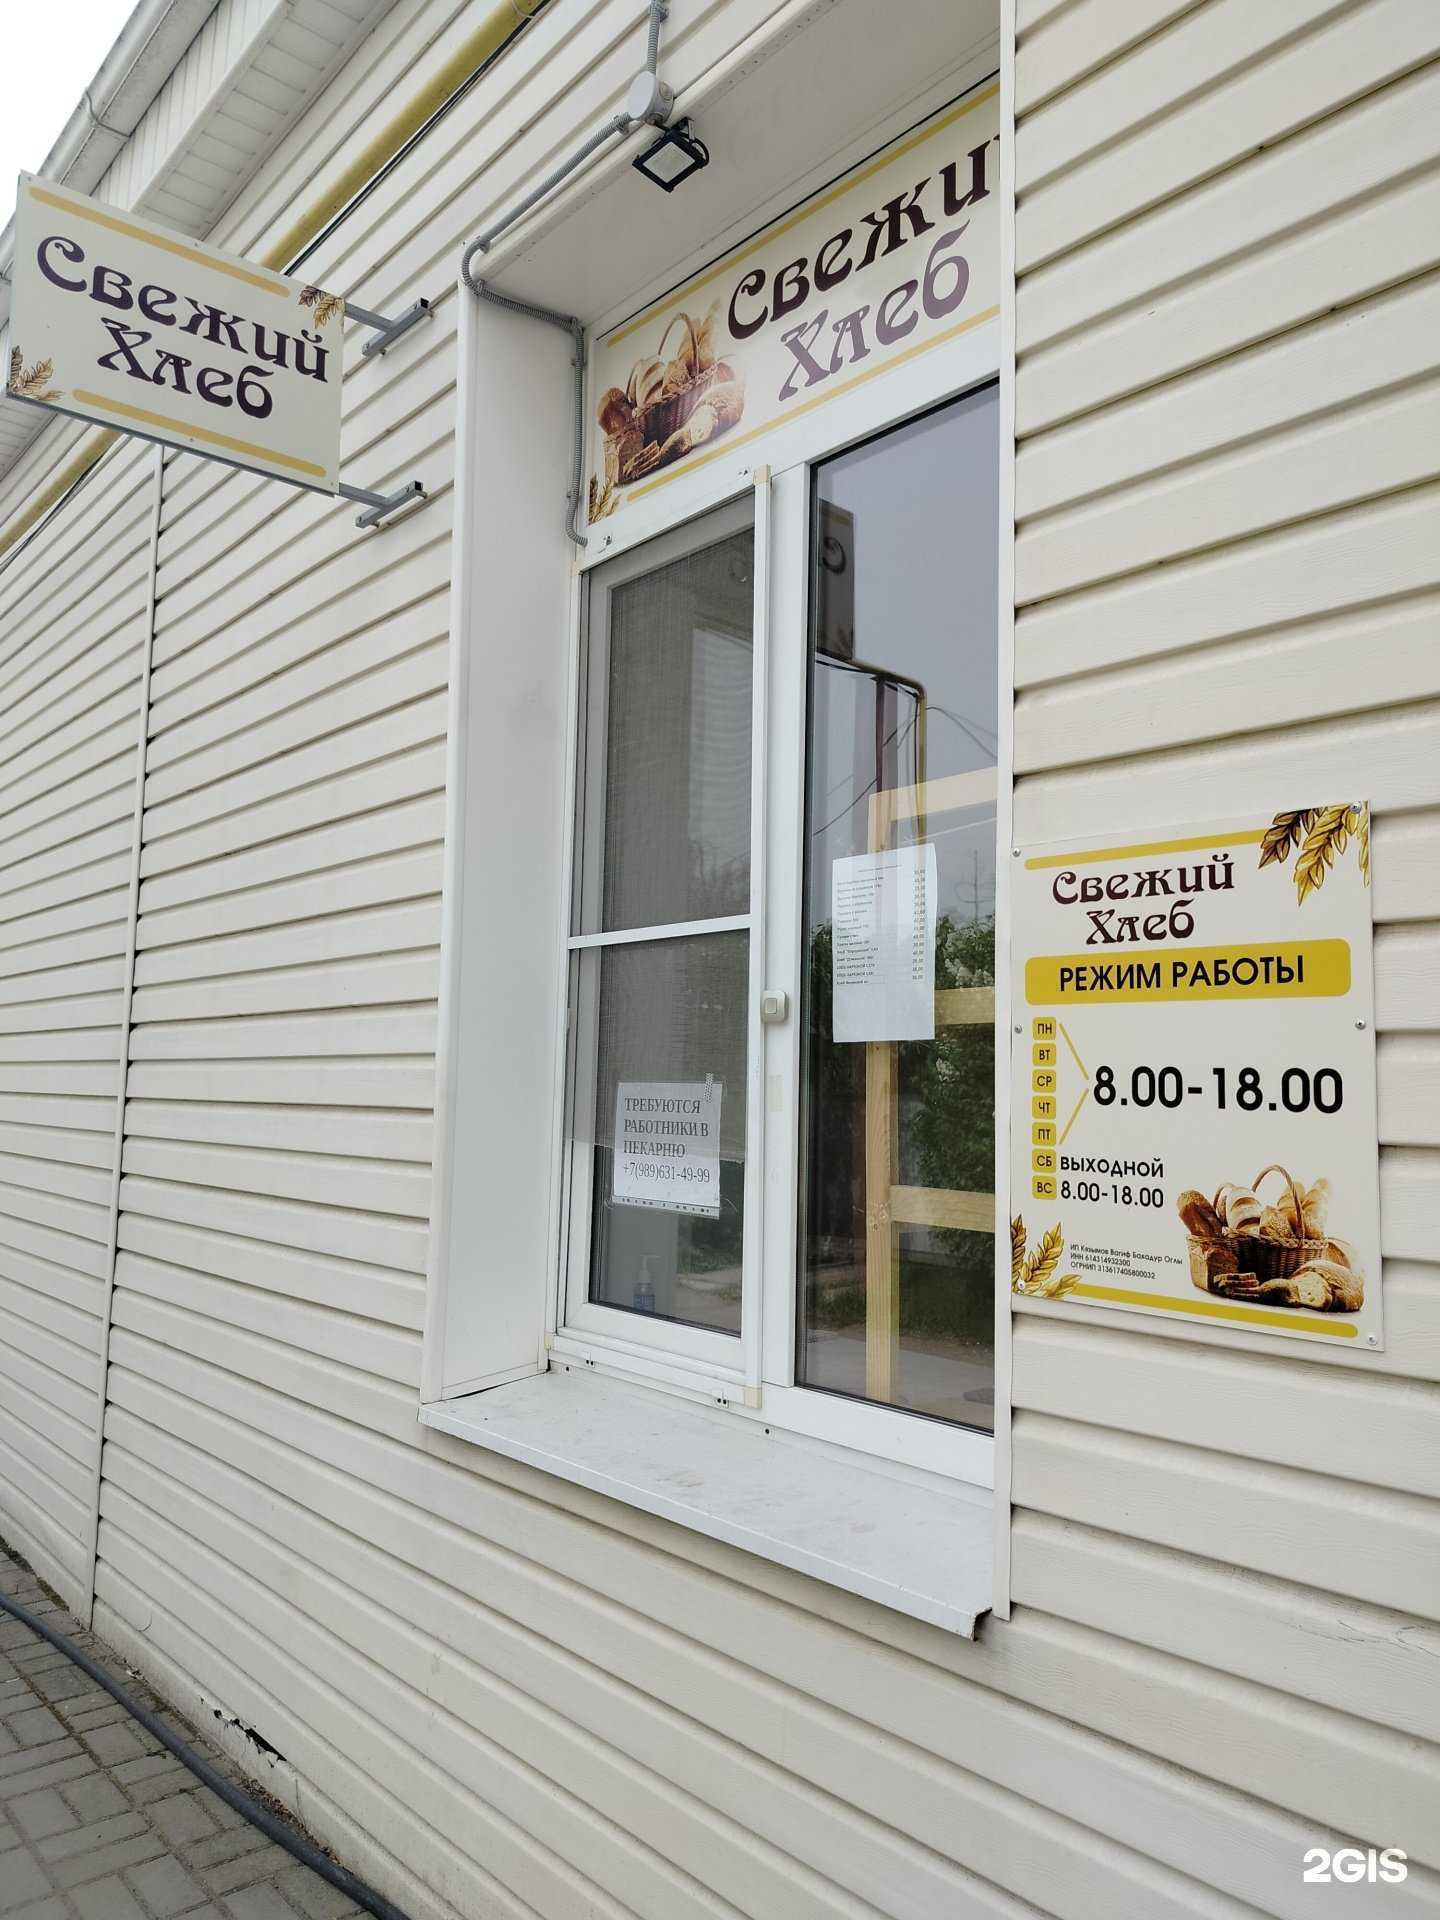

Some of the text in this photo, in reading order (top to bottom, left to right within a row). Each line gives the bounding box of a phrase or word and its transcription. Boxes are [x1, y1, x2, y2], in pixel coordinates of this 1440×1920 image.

[728, 134, 1000, 340] Свежи
[37, 235, 330, 383] Свежий
[778, 218, 971, 401] Хлеб
[97, 317, 274, 419] Хлеб
[1052, 853, 1235, 905] Свежий
[1086, 898, 1195, 945] Хлеб
[1059, 955, 1304, 992] РЕЖИМ РАБОТЫ
[1037, 1023, 1053, 1035] ПН
[1039, 1049, 1051, 1061] ВТ
[1036, 1075, 1053, 1087] СР
[1093, 1065, 1344, 1114] 8.00-18.00
[624, 1097, 701, 1114] ТРЕБУЮТСЯ
[1038, 1102, 1051, 1113] ЧТ
[623, 1119, 709, 1137] РАБОТНИКИ В
[1038, 1128, 1051, 1140] ПТ
[623, 1140, 686, 1158] ПЕКАРНЮ
[1036, 1155, 1052, 1167] СБ
[623, 1162, 710, 1183] +7(989)631-49-99
[1036, 1182, 1053, 1194] ВС
[1060, 1181, 1164, 1208] 8.00-18.00
[1070, 1252, 1084, 1260] ИНН
